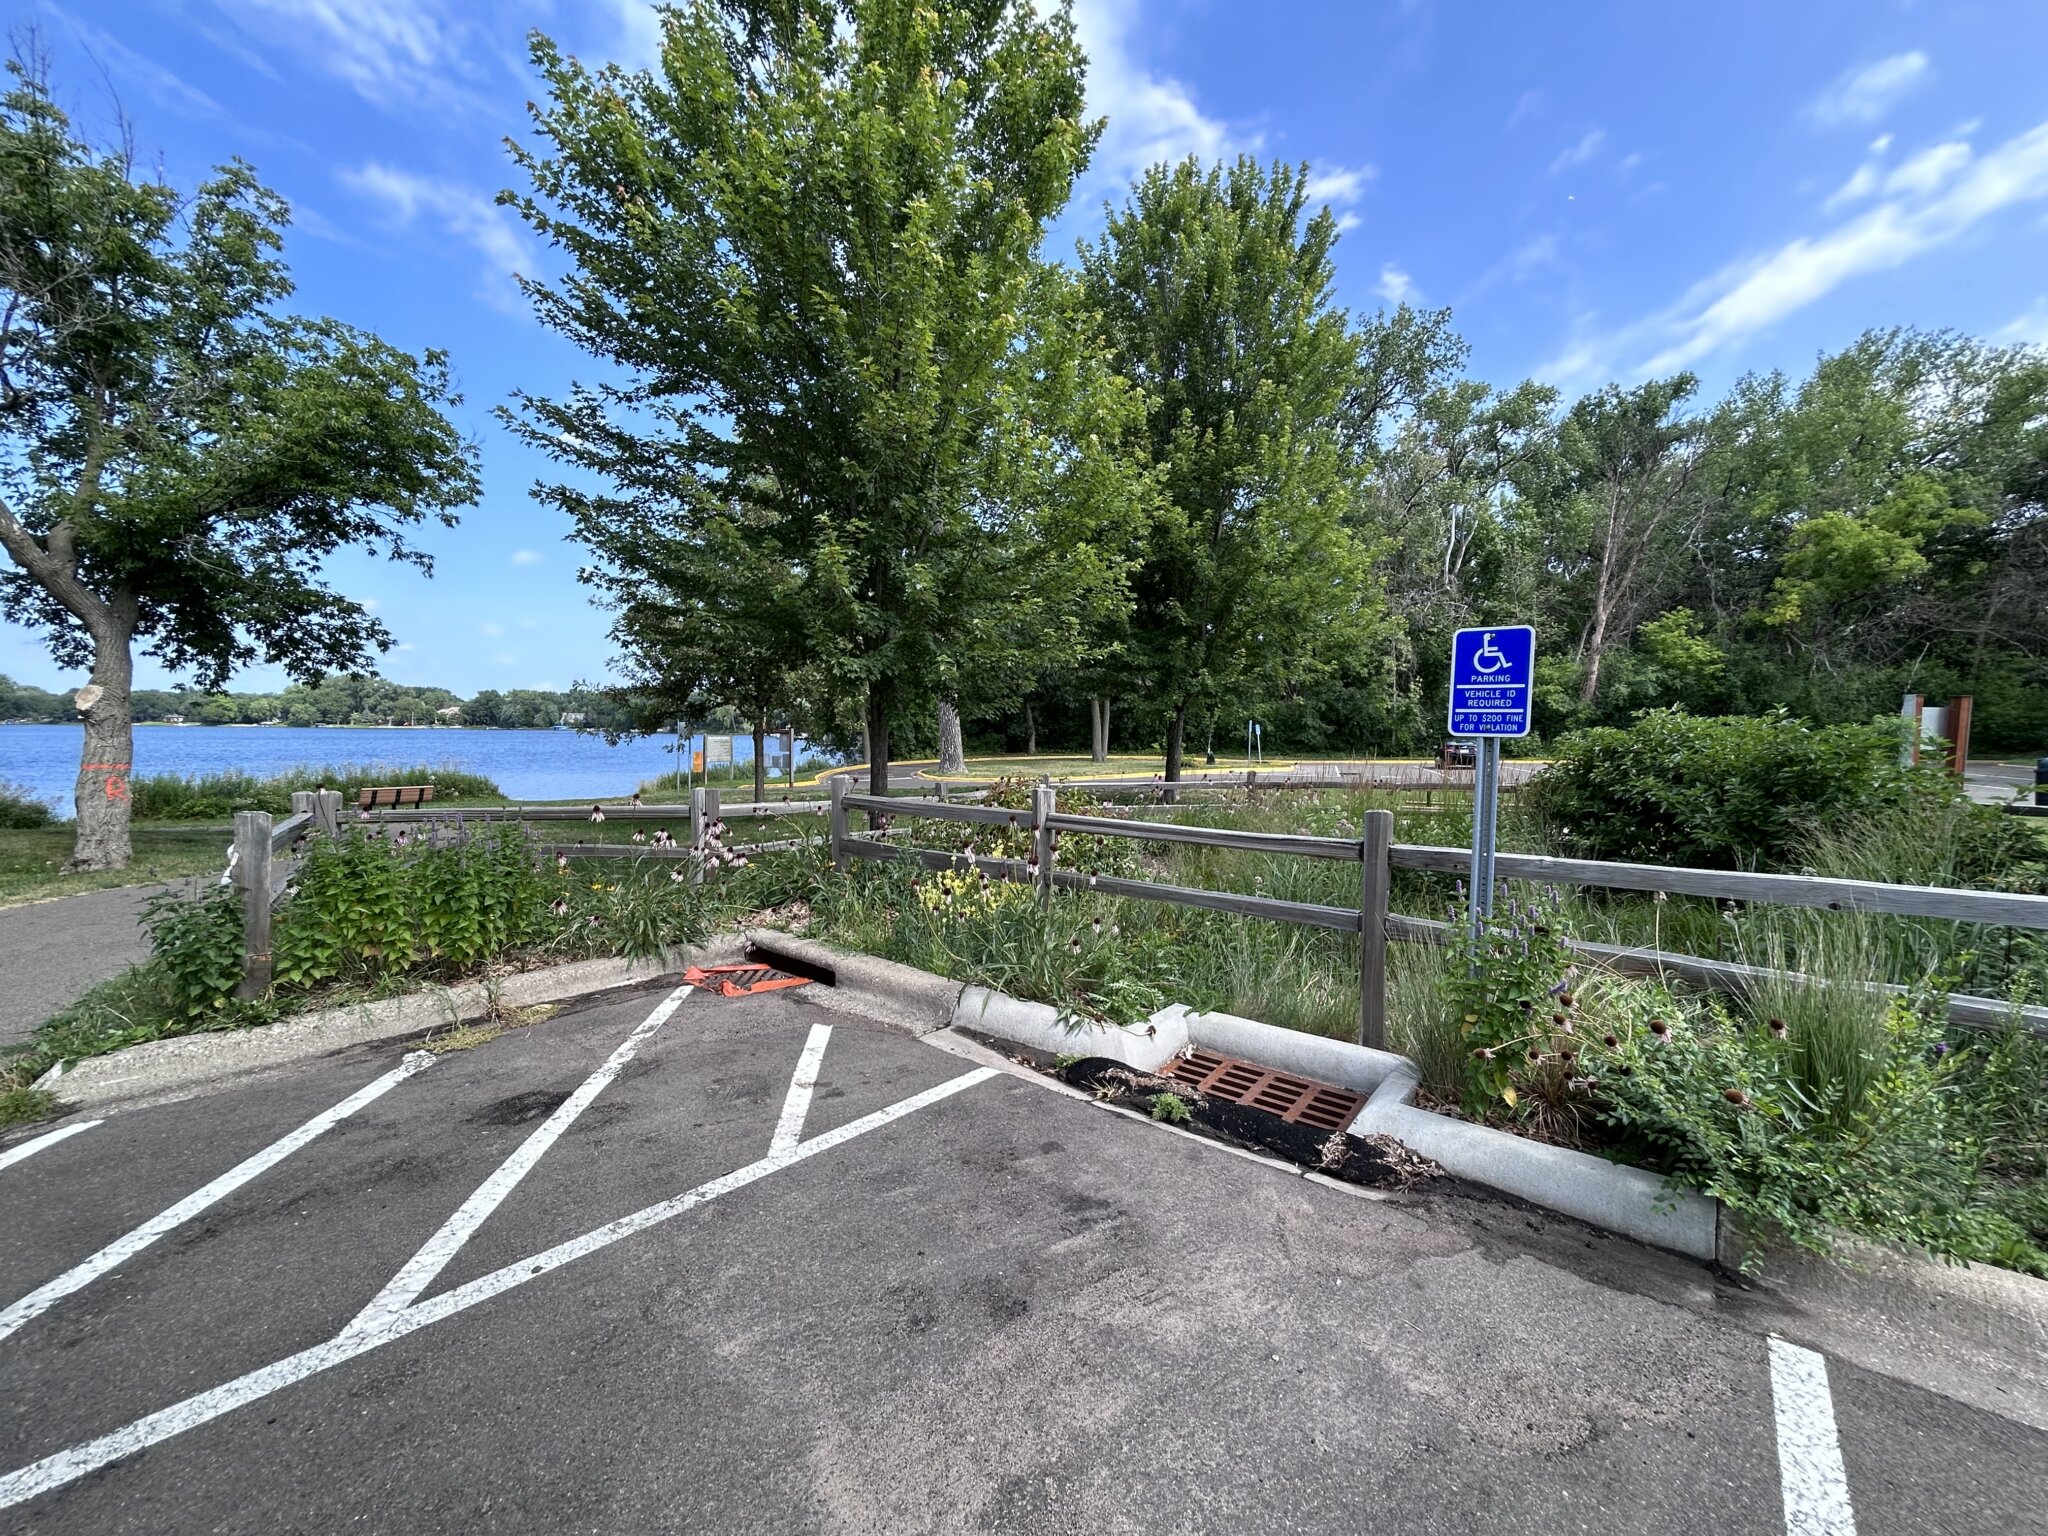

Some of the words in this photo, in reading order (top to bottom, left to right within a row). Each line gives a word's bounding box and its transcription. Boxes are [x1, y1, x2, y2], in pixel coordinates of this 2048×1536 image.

[1468, 699, 1512, 707] REQUIRED
[1454, 714, 1464, 722] UP
[1469, 714, 1478, 722] TO
[1482, 714, 1502, 722] $200
[1506, 714, 1524, 722] FINE
